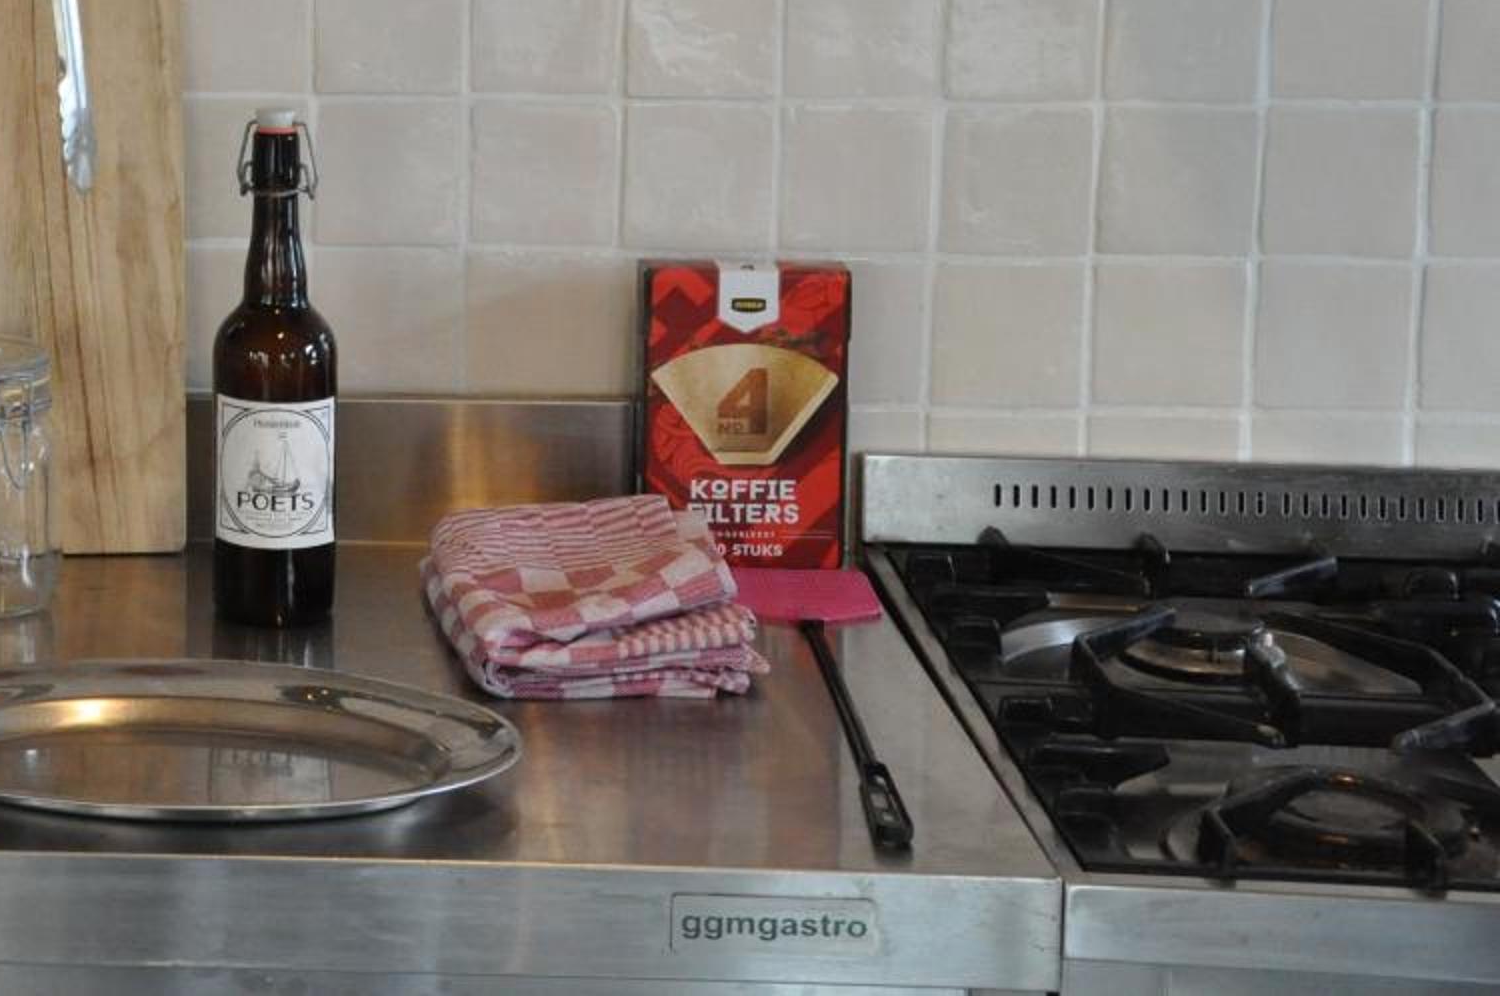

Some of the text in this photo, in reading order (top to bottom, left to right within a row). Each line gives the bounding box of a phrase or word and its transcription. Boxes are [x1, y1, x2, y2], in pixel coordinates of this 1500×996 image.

[717, 367, 768, 434] 4
[690, 479, 797, 500] KOFFIE
[237, 491, 315, 512] POETS
[732, 543, 784, 556] STUKS
[681, 913, 868, 941] ggmgastro
